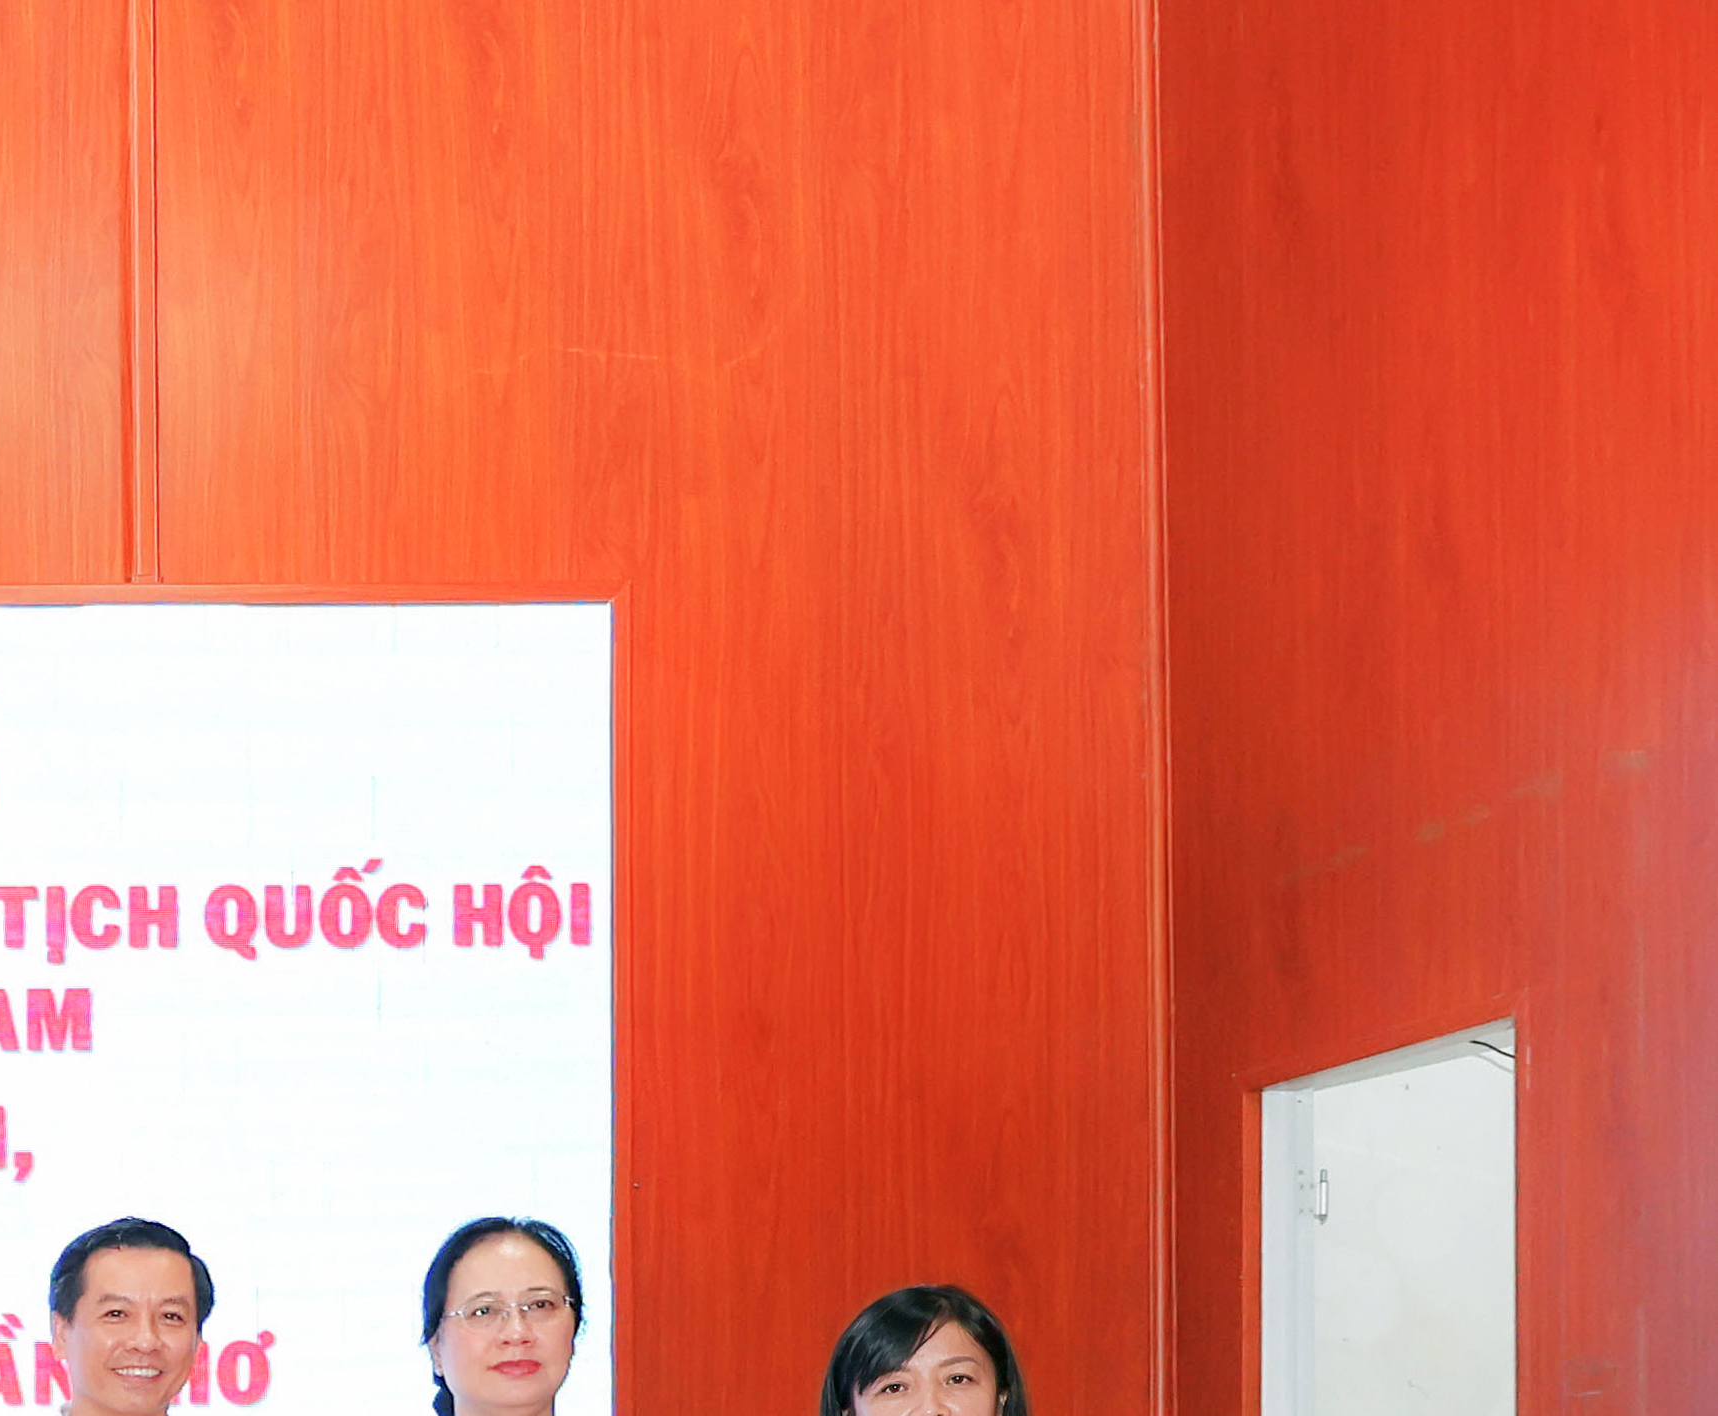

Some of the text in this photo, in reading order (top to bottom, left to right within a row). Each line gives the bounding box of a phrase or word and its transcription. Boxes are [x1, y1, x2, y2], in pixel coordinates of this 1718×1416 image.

[204, 858, 427, 961] QUỐC
[453, 865, 592, 960] HỘI
[171, 1331, 276, 1406] HƠ
